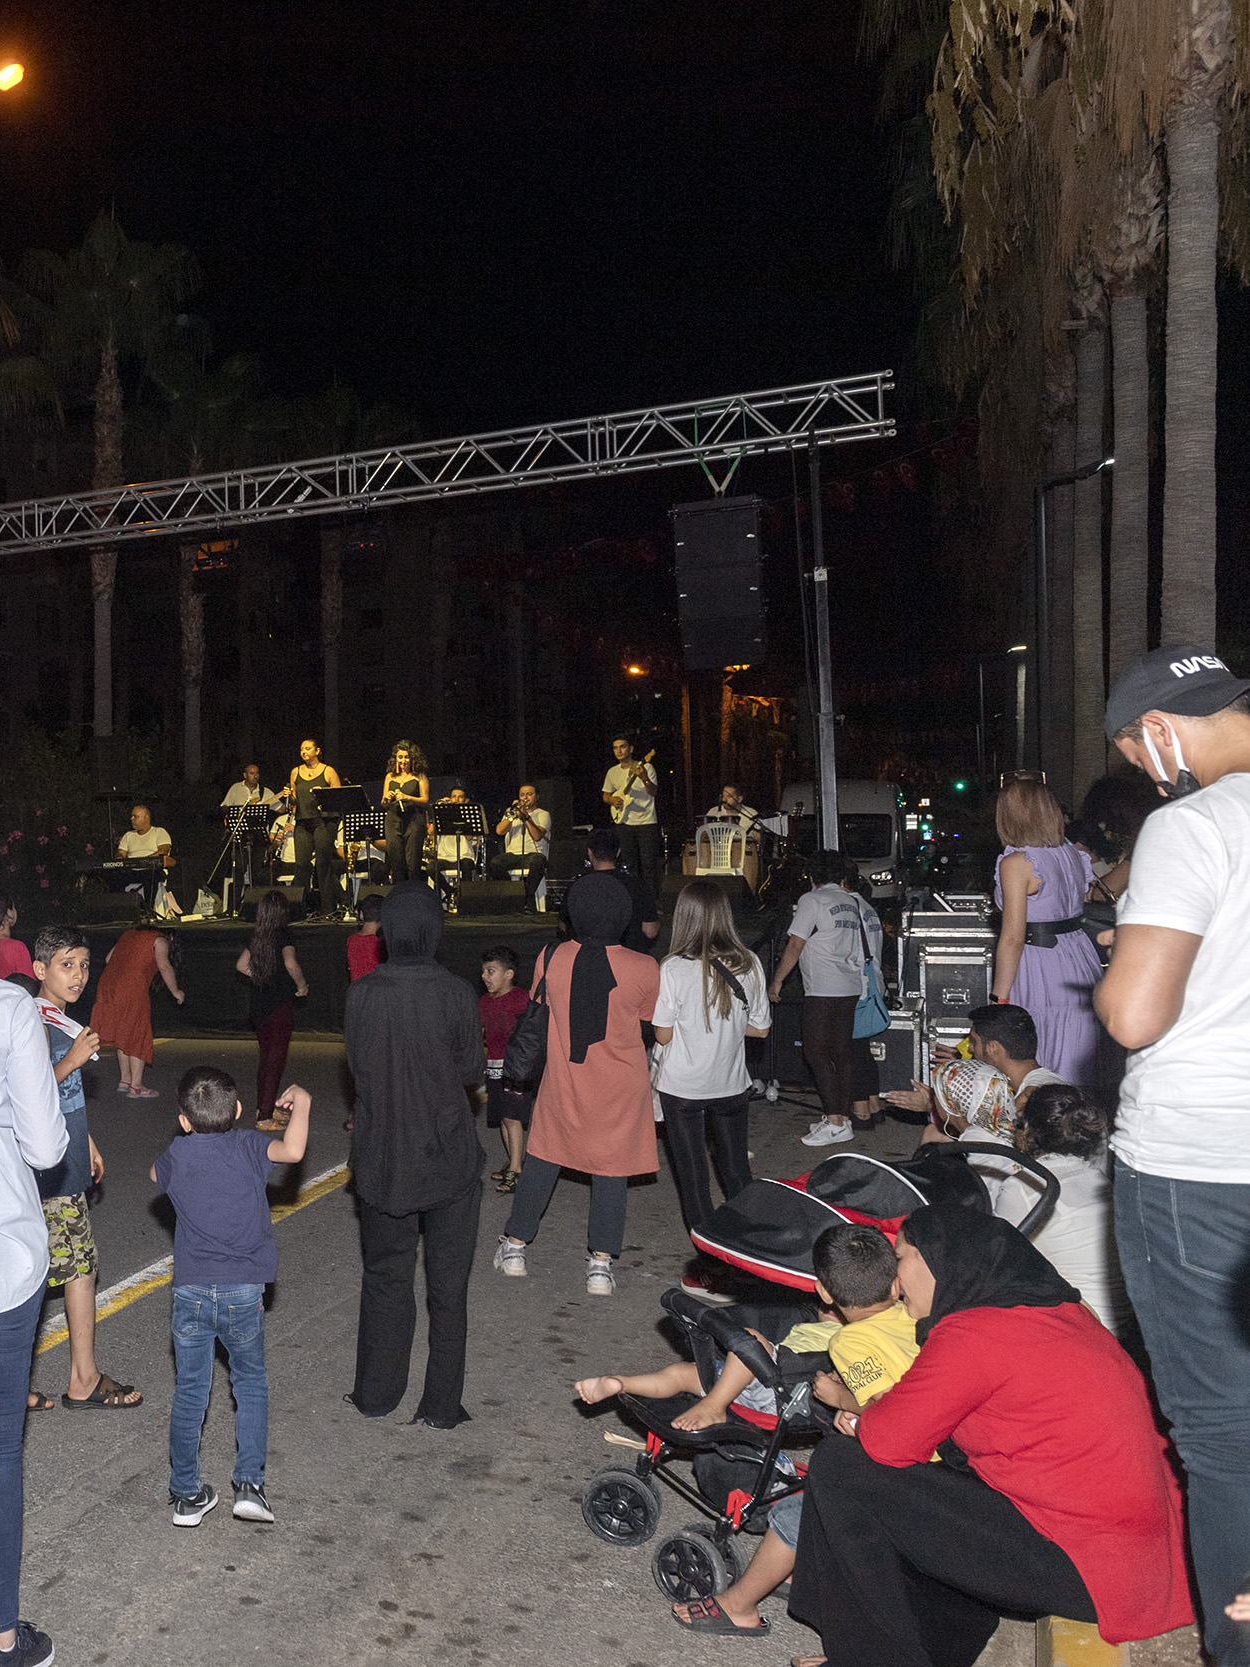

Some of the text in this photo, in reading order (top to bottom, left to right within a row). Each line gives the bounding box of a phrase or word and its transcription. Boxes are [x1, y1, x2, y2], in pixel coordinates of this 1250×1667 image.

[1169, 655, 1230, 678] NASA
[841, 1356, 882, 1388] 2021
[851, 1380, 866, 1394] OYAL
